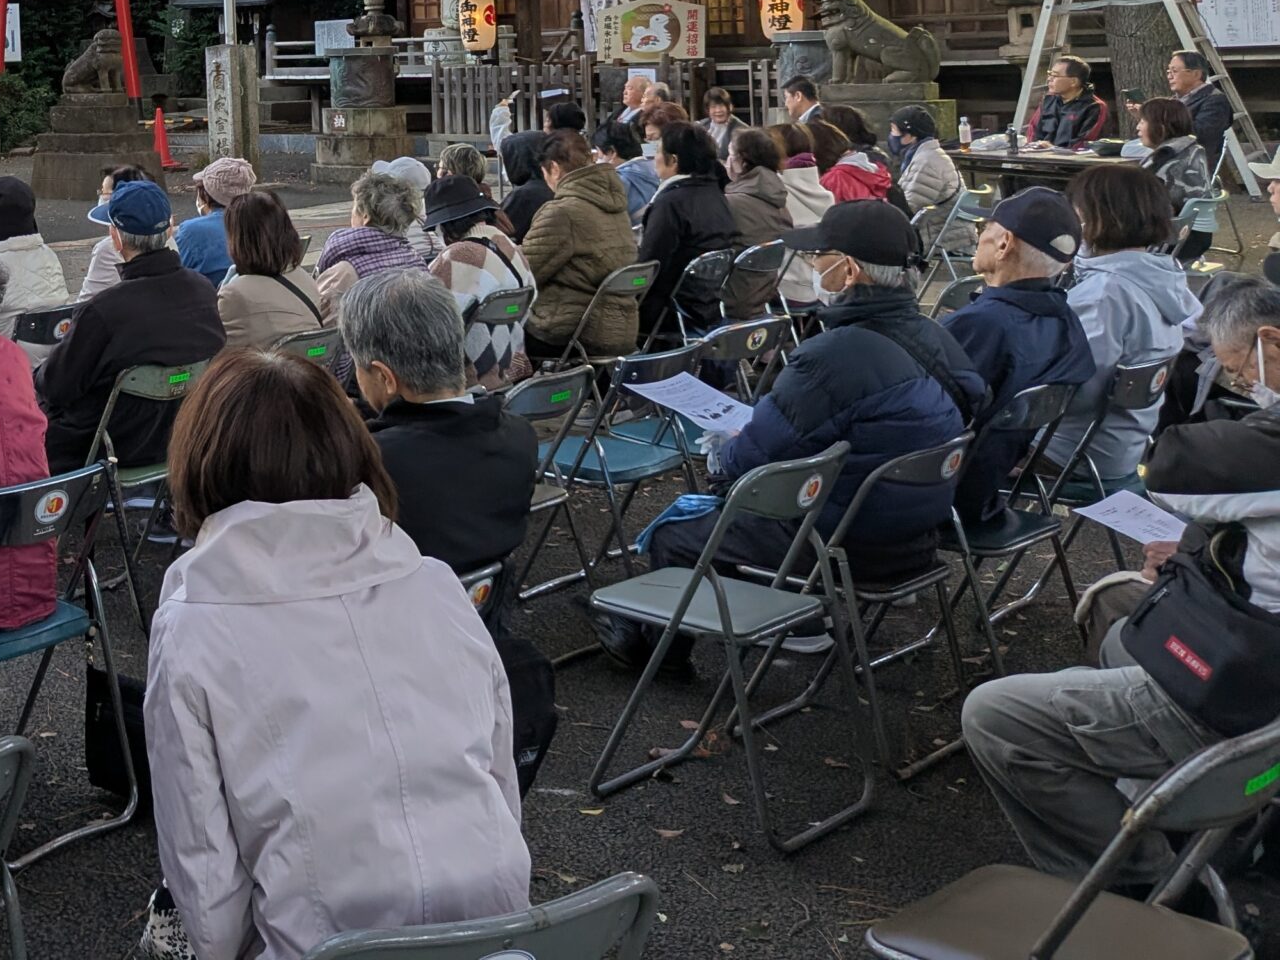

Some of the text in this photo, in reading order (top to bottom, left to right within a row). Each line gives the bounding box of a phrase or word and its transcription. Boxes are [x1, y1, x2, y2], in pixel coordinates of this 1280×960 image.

[460, 0, 480, 43] 御神燈
[604, 15, 612, 60] 西堀氷川神社
[686, 9, 699, 57] 開運招福
